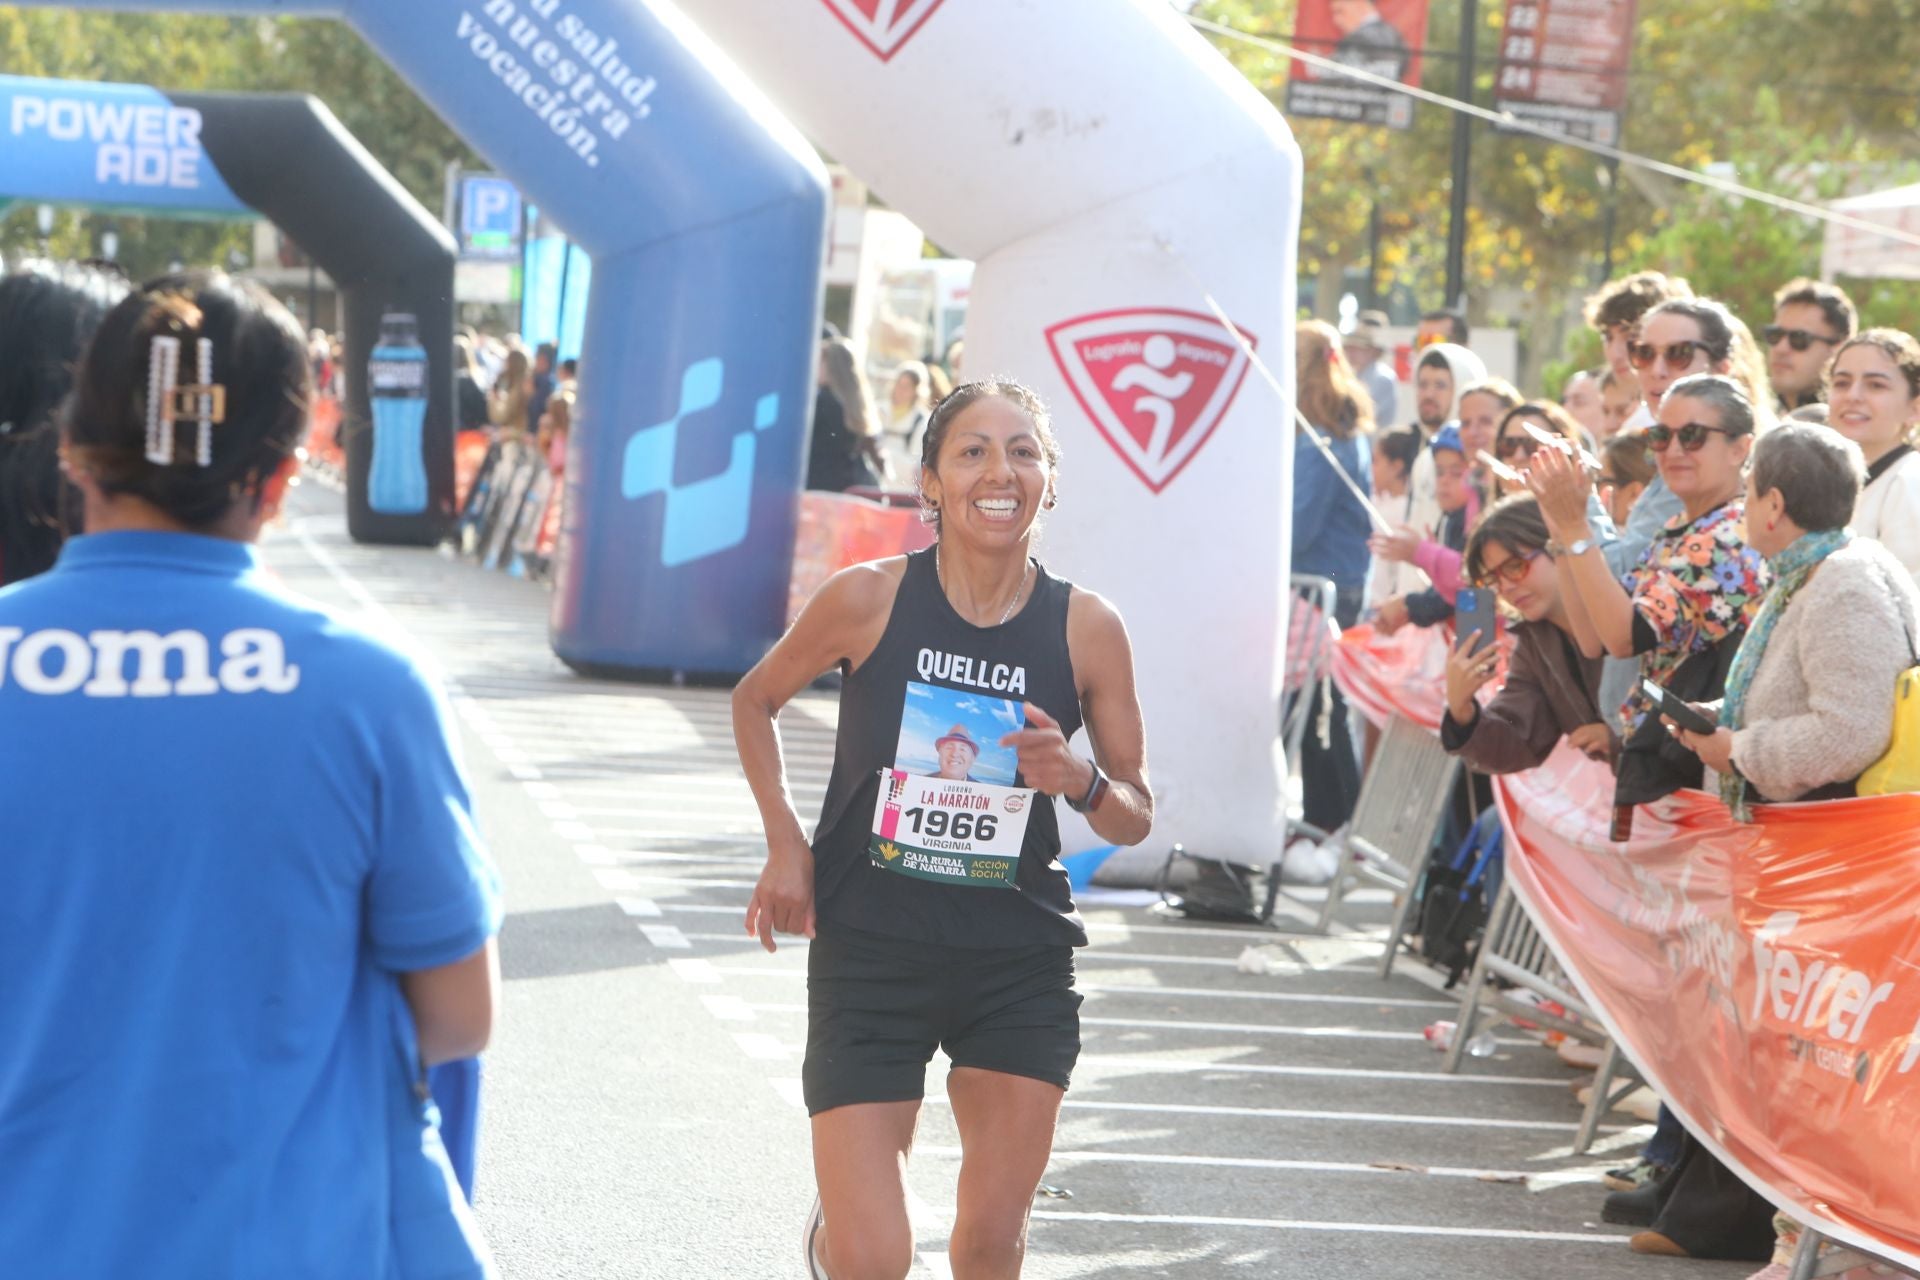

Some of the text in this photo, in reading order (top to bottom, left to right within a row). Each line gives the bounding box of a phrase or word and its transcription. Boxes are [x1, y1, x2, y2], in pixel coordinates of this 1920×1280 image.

[483, 0, 631, 140] nuestra
[555, 13, 657, 119] salud,
[456, 10, 599, 168] vocación.
[11, 96, 203, 147] POWER
[96, 143, 201, 188] ADE
[475, 188, 508, 226] P
[916, 647, 1026, 695] QUELLCA
[920, 790, 935, 805] LA
[938, 792, 991, 811] MARATÓN
[904, 806, 999, 842] 1966
[904, 851, 964, 868] CAJA RURAL
[921, 837, 972, 852] VIRGINIA
[902, 858, 918, 870] DE
[919, 862, 967, 877] NAVARRA
[971, 859, 1009, 871] ACCIÓN
